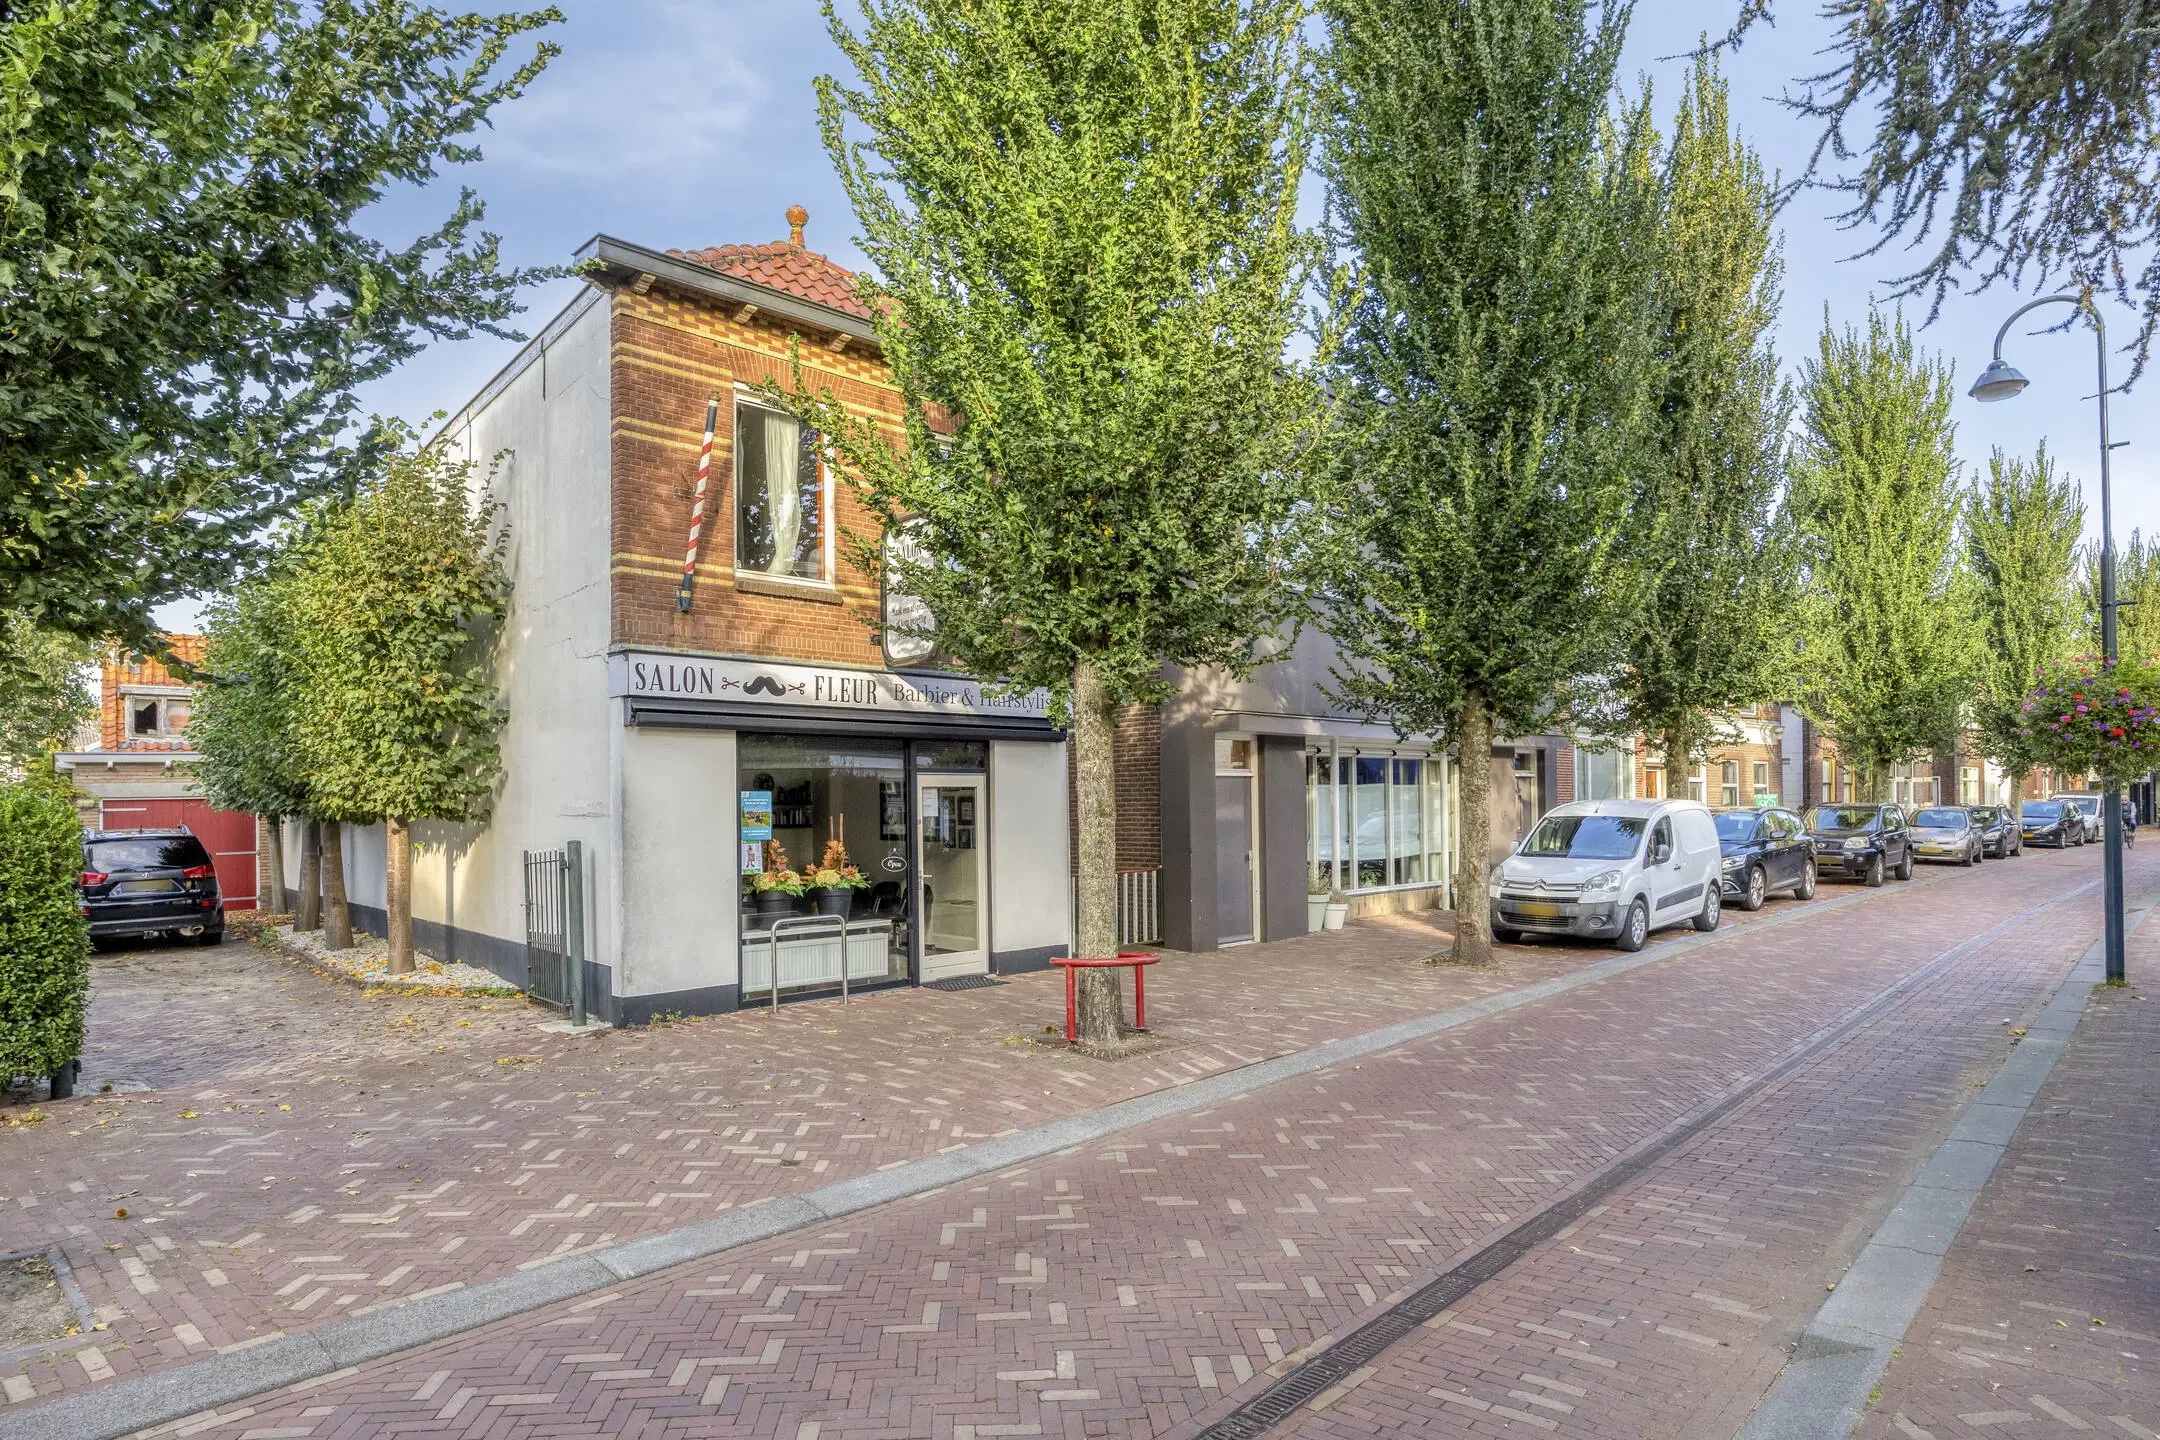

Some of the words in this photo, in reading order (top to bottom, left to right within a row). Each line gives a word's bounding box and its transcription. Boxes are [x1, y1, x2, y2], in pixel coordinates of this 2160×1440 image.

[634, 662, 714, 694] SALON
[814, 674, 878, 705] FLEUR
[893, 683, 958, 705] Barbier
[961, 687, 975, 707] &
[980, 688, 1051, 713] Hairstylis
[887, 859, 902, 869] Open
